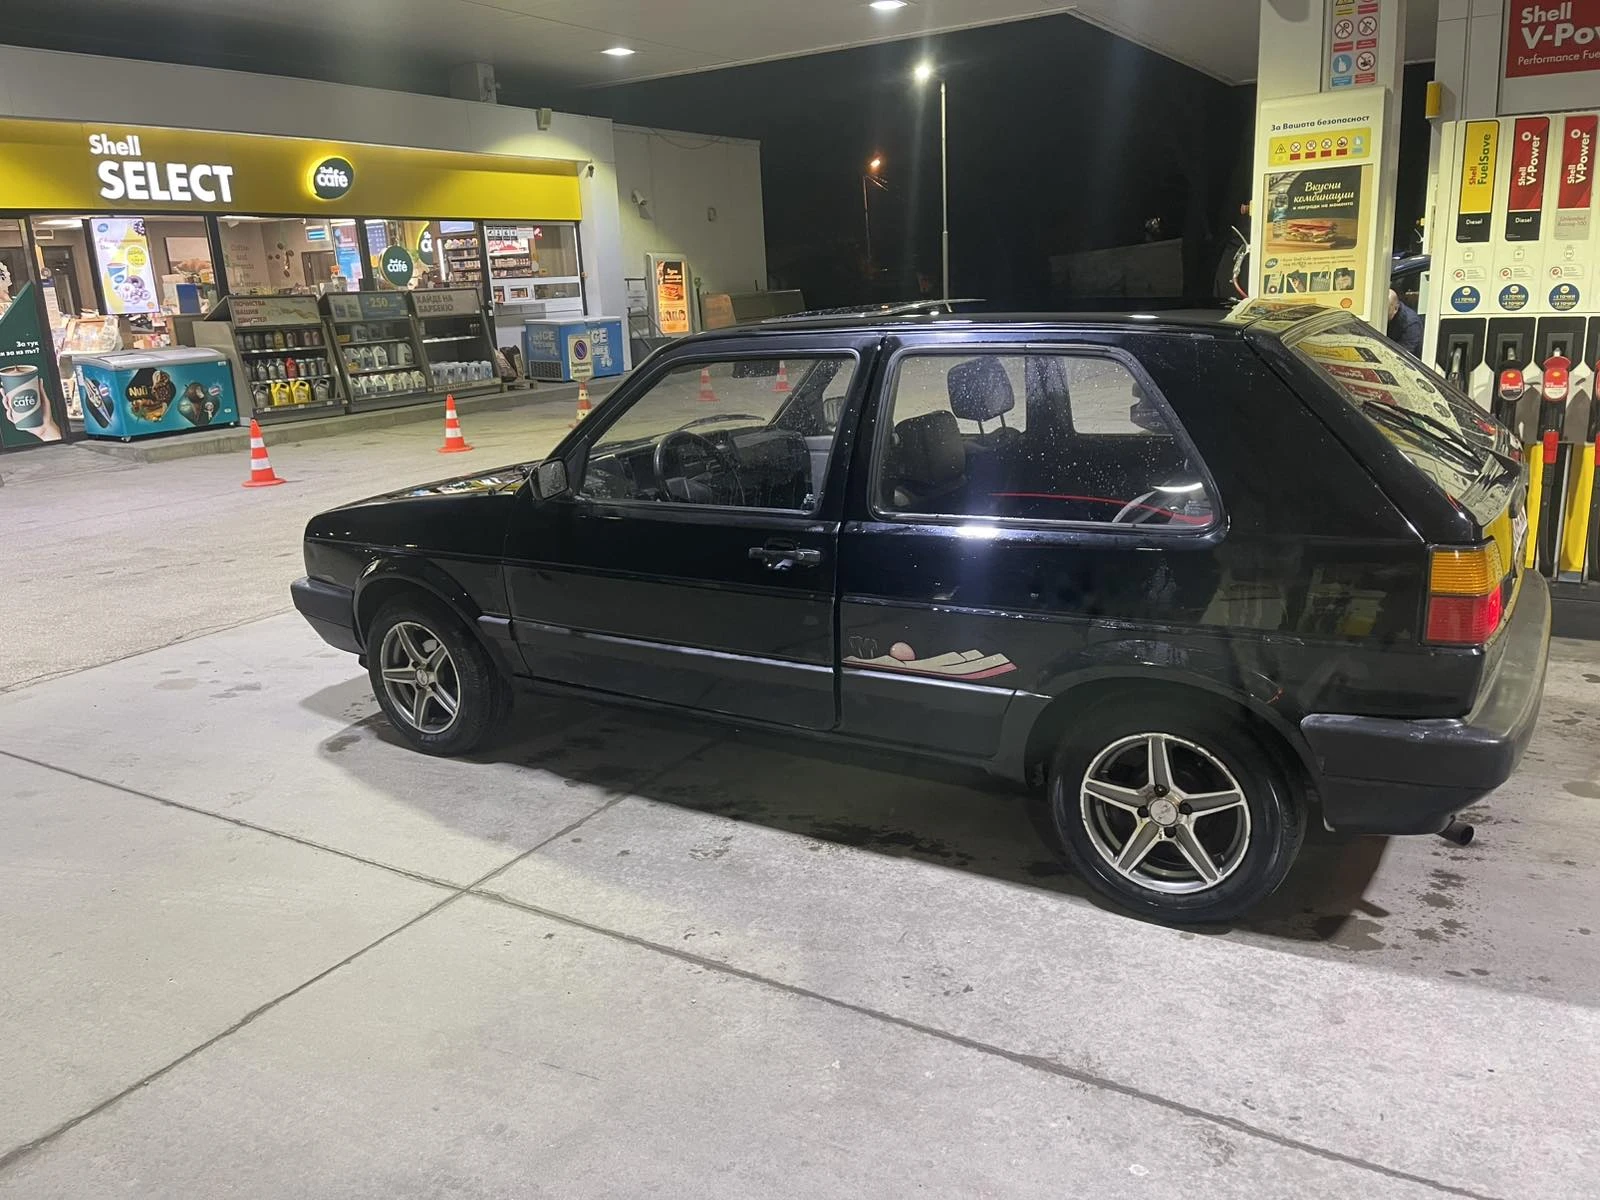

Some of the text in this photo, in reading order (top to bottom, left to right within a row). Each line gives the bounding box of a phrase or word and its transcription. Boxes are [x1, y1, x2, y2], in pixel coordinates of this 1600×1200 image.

[1521, 2, 1572, 24] Shell
[1521, 23, 1600, 50] V-Po
[1517, 53, 1581, 66] Performance
[1271, 115, 1370, 132] За Вашата безопасност
[88, 133, 141, 156] Shell
[1478, 133, 1491, 185] FuelSave
[1526, 135, 1541, 185] V-Power
[1575, 132, 1590, 184] V-Power
[97, 160, 233, 203] SELECT
[316, 169, 349, 188] café
[1469, 166, 1478, 185] Shell
[1518, 167, 1527, 186] Shell
[1567, 164, 1576, 184] Shell
[1304, 181, 1341, 193] Вкусни
[1293, 191, 1354, 203] комбинации
[387, 259, 408, 272] café
[13, 395, 36, 407] café
